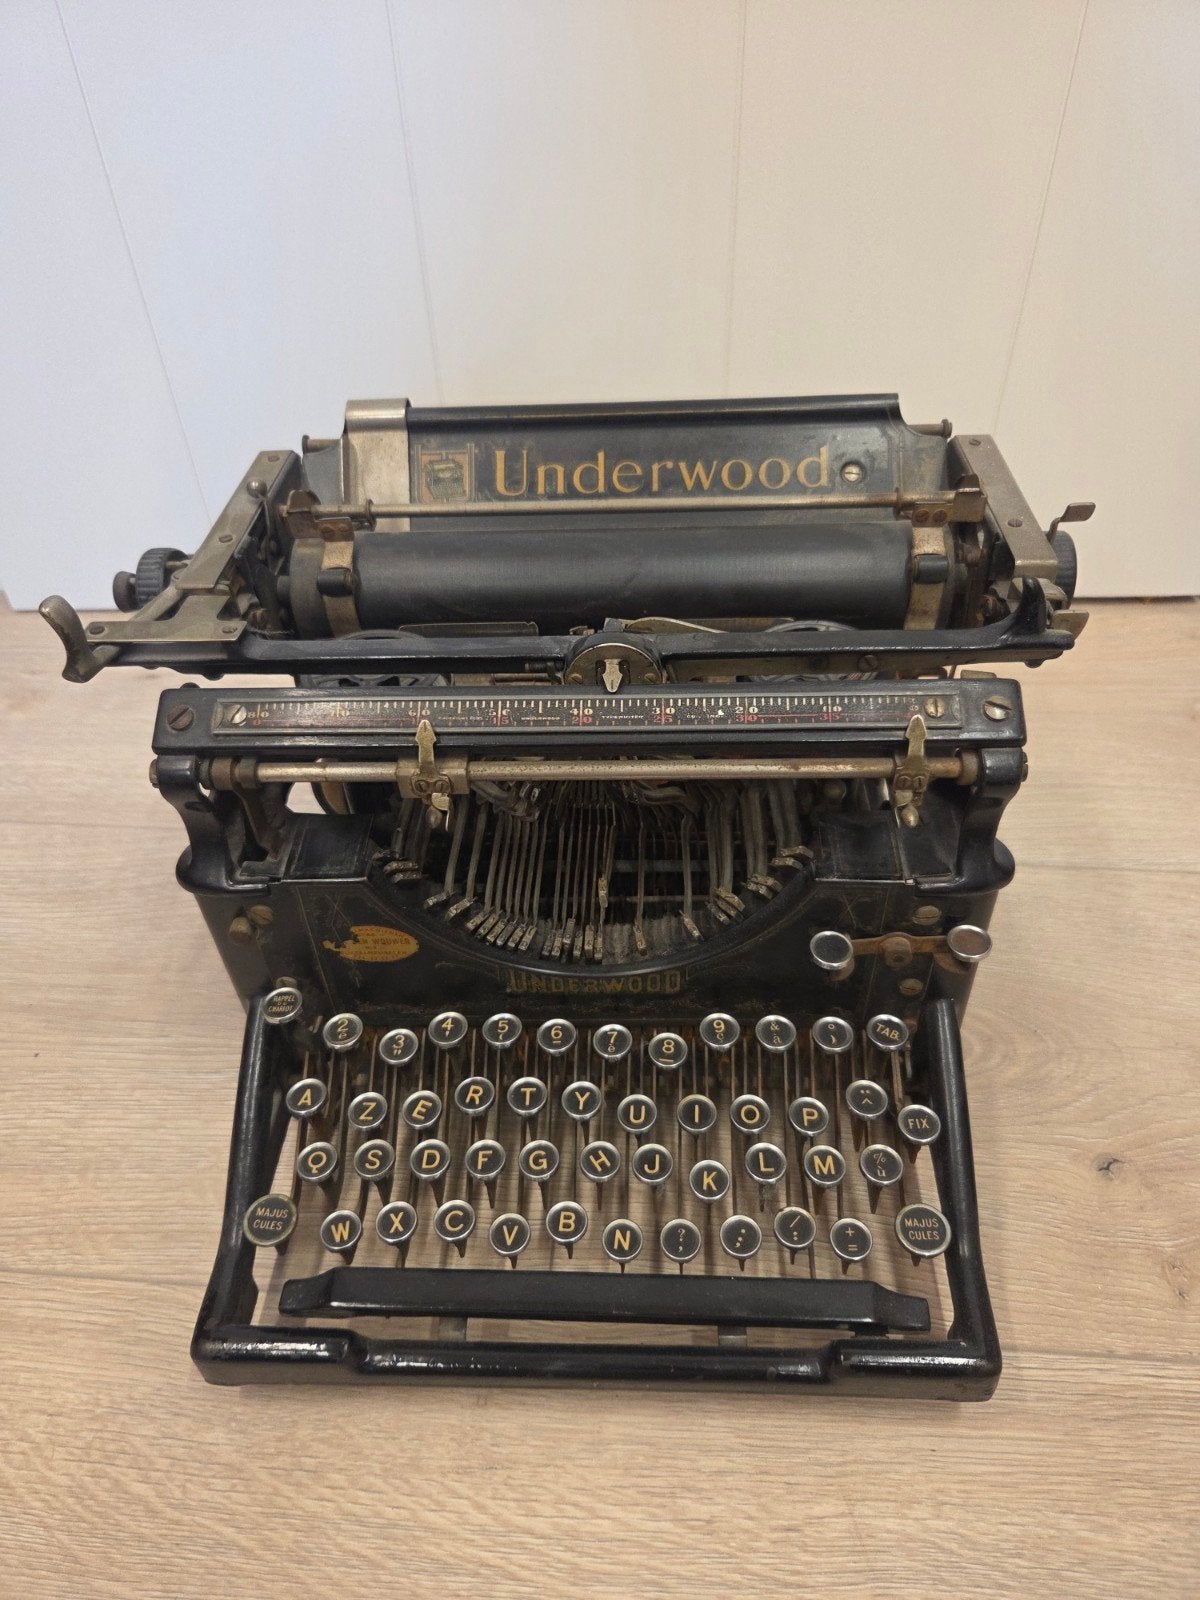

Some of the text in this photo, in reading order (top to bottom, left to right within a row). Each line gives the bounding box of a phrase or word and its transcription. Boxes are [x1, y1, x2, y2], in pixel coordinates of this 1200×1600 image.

[494, 445, 831, 497] Underwood
[569, 708, 594, 716] 40
[651, 707, 676, 715] 30
[735, 706, 759, 714] 20
[572, 716, 593, 724] 20
[507, 967, 682, 993] UNDERWOOD
[337, 1020, 349, 1033] 2
[442, 1019, 454, 1032] 4
[497, 1020, 509, 1033] 5
[551, 1026, 563, 1039] 6
[713, 1020, 725, 1033] 9
[875, 1023, 901, 1041] TAB
[394, 1035, 405, 1049] 3
[607, 1031, 618, 1044] 7
[662, 1040, 675, 1054] 8
[298, 1089, 312, 1106] A
[465, 1086, 484, 1105] R
[521, 1088, 536, 1106] T
[575, 1092, 590, 1110] Y
[359, 1102, 377, 1120] Z
[411, 1100, 433, 1120] E
[630, 1105, 645, 1124] U
[694, 1105, 699, 1123] I
[741, 1105, 760, 1124] O
[802, 1108, 819, 1126] P
[908, 1118, 930, 1130] FIX
[307, 1151, 327, 1174] Q
[365, 1150, 383, 1170] S
[421, 1150, 441, 1169] D
[477, 1150, 493, 1170] F
[528, 1151, 548, 1170] G
[589, 1150, 611, 1172] H
[644, 1154, 660, 1174] J
[758, 1152, 774, 1172] L
[813, 1155, 836, 1176] M
[702, 1171, 718, 1191] K
[256, 1207, 289, 1218] MAJUS
[444, 1210, 464, 1232] C
[253, 1221, 283, 1231] CULES
[389, 1212, 405, 1234] X
[558, 1212, 576, 1232] B
[905, 1218, 939, 1228] MAJUS
[331, 1221, 350, 1243] W
[502, 1225, 519, 1246] V
[613, 1229, 631, 1250] N
[908, 1231, 940, 1241] CULES
